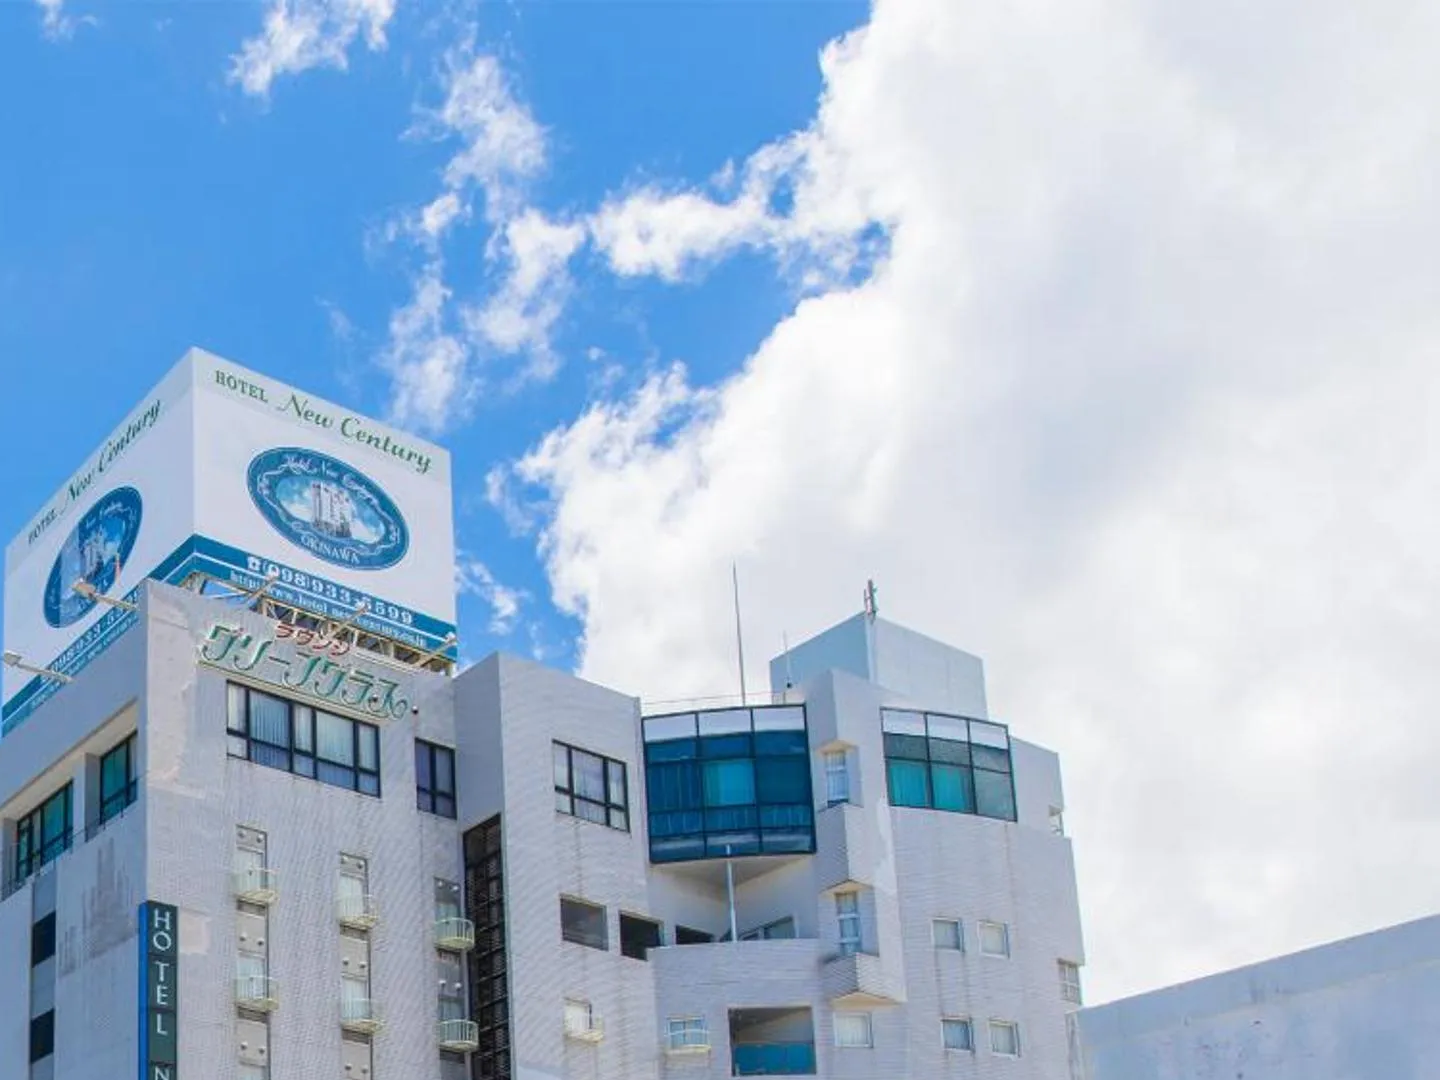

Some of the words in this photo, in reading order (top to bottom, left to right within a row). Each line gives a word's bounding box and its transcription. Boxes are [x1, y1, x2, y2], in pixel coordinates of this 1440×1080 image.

[215, 369, 268, 403] HOTEL
[276, 391, 335, 430] New
[340, 416, 433, 474] Century
[300, 534, 361, 564] OKINAWA
[152, 907, 172, 1036] HOTEL
